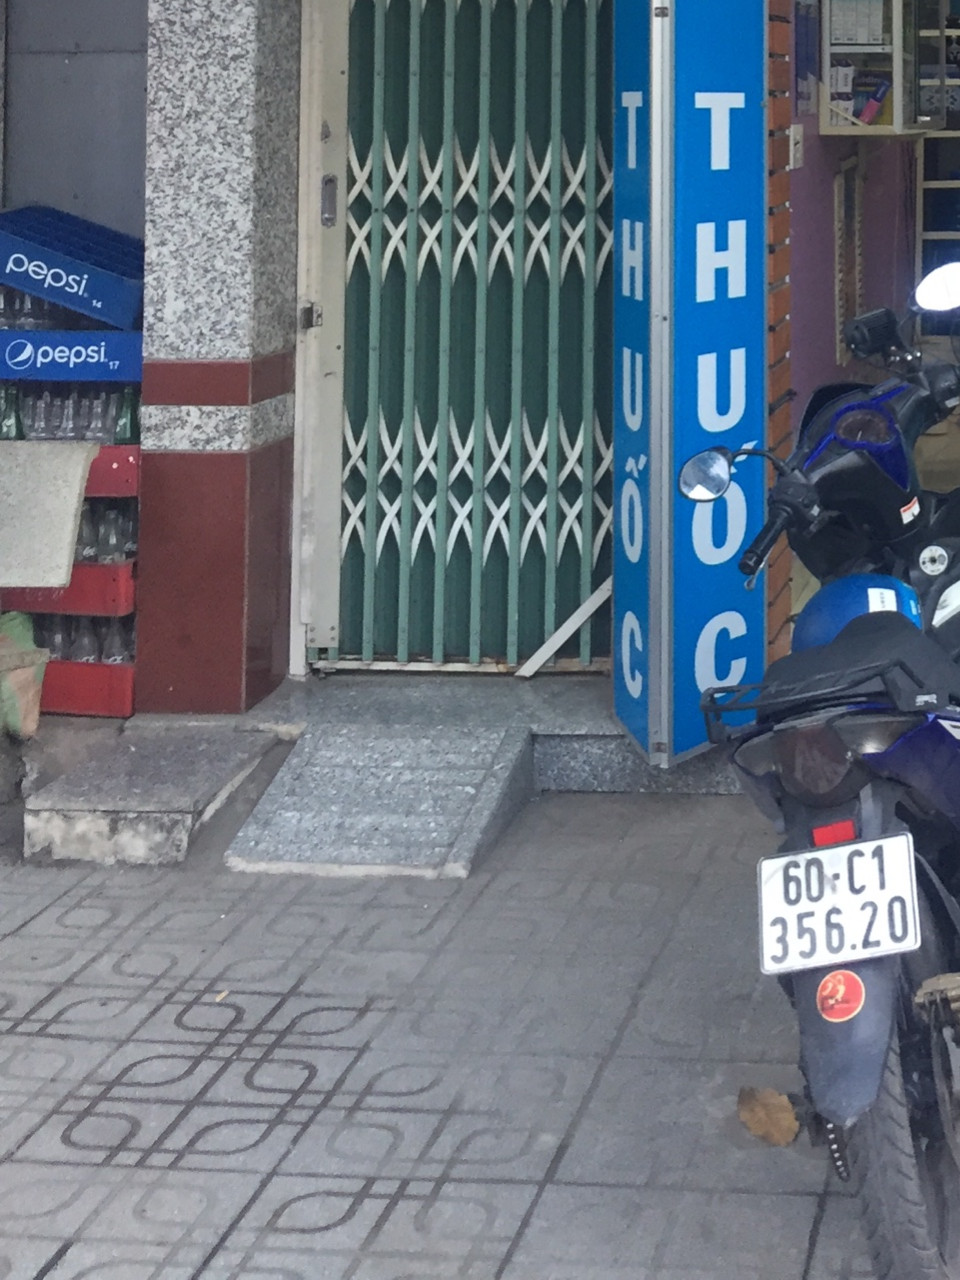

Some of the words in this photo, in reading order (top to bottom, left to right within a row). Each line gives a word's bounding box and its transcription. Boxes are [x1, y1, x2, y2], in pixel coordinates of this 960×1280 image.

[6, 253, 88, 296] pepsi
[36, 341, 106, 368] pepsi
[109, 361, 120, 370] 17
[621, 91, 648, 699] THUỐC
[692, 91, 747, 697] THUỐC
[783, 844, 886, 906] 60-C1
[770, 895, 908, 964] 356.20
